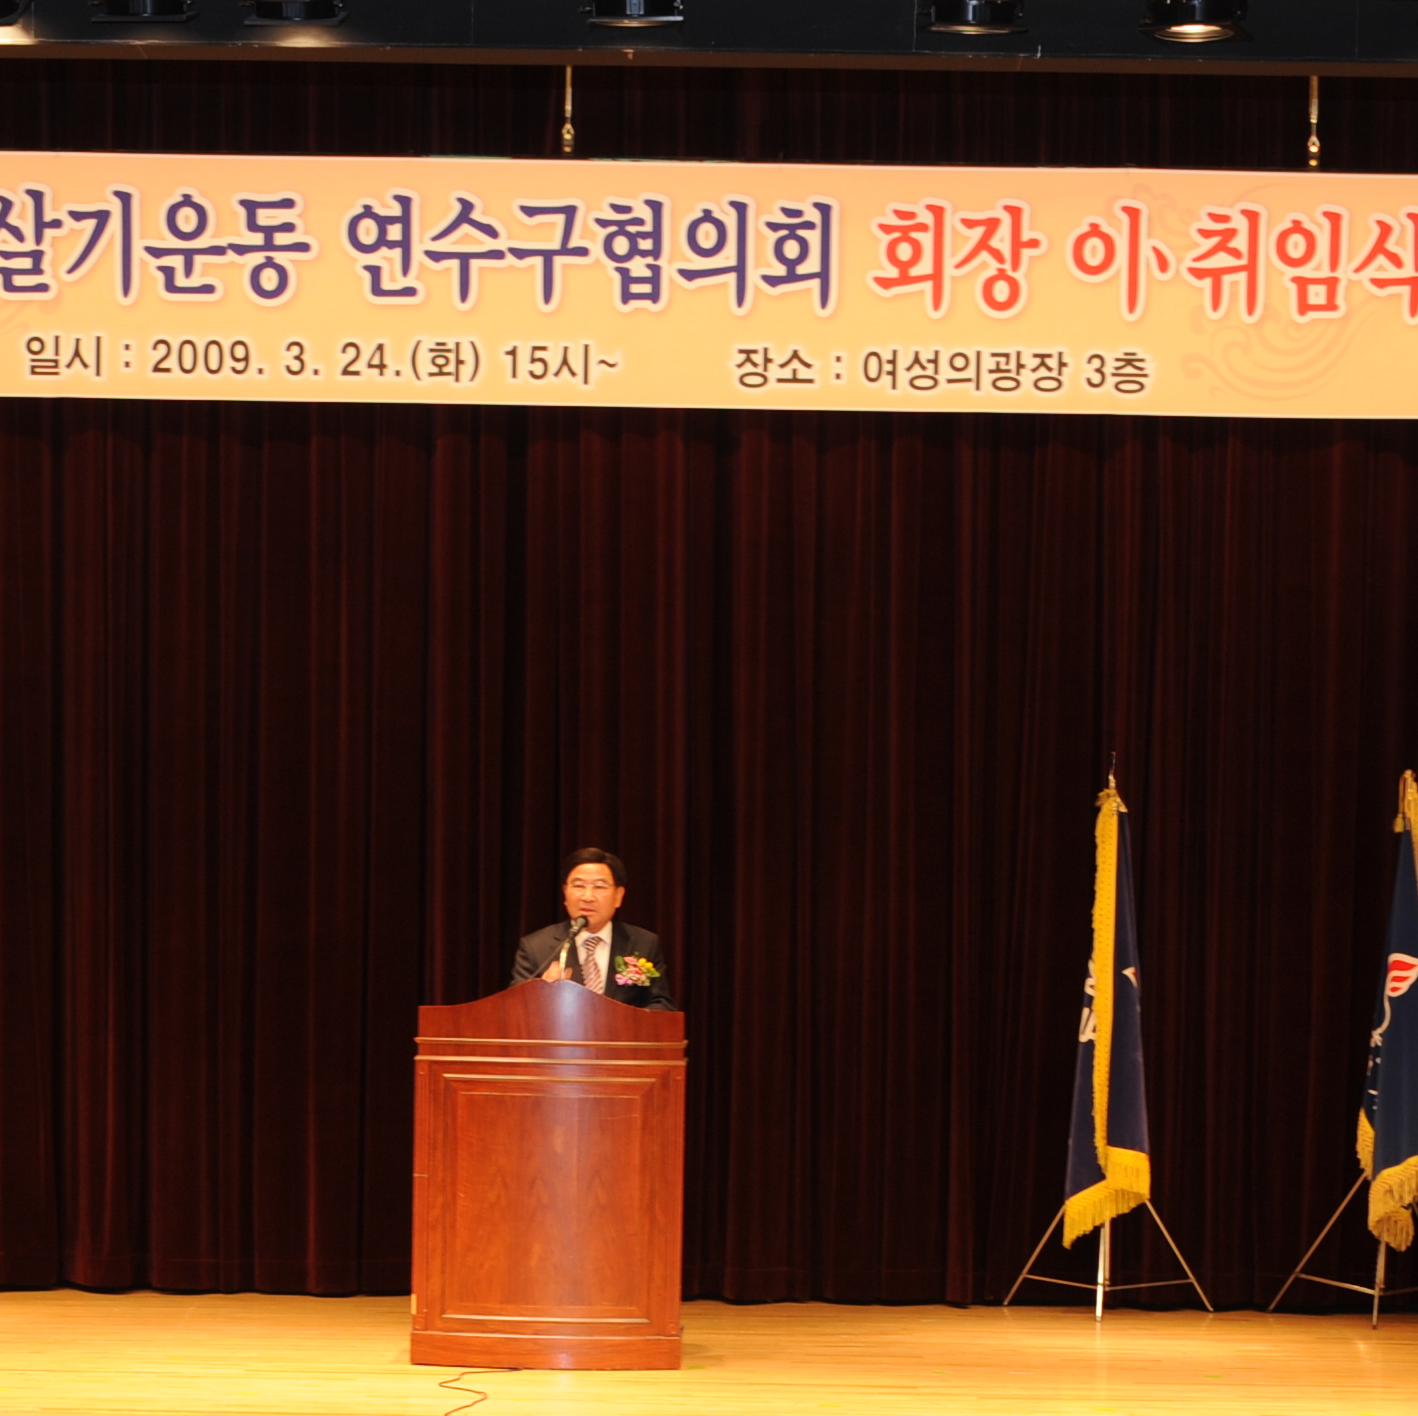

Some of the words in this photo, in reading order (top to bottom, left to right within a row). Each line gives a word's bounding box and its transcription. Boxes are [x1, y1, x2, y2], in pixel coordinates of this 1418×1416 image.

[346, 193, 833, 310] 연수구협의회
[872, 202, 1041, 313] 회장
[25, 334, 102, 378] 일시
[151, 338, 265, 376] 2009.
[284, 341, 320, 377] 3.
[340, 341, 481, 384] 24.(화)
[504, 344, 618, 386] 15시~
[735, 346, 815, 390] 장소
[862, 349, 1069, 394] 여성의광장
[1085, 351, 1150, 395] 3층
